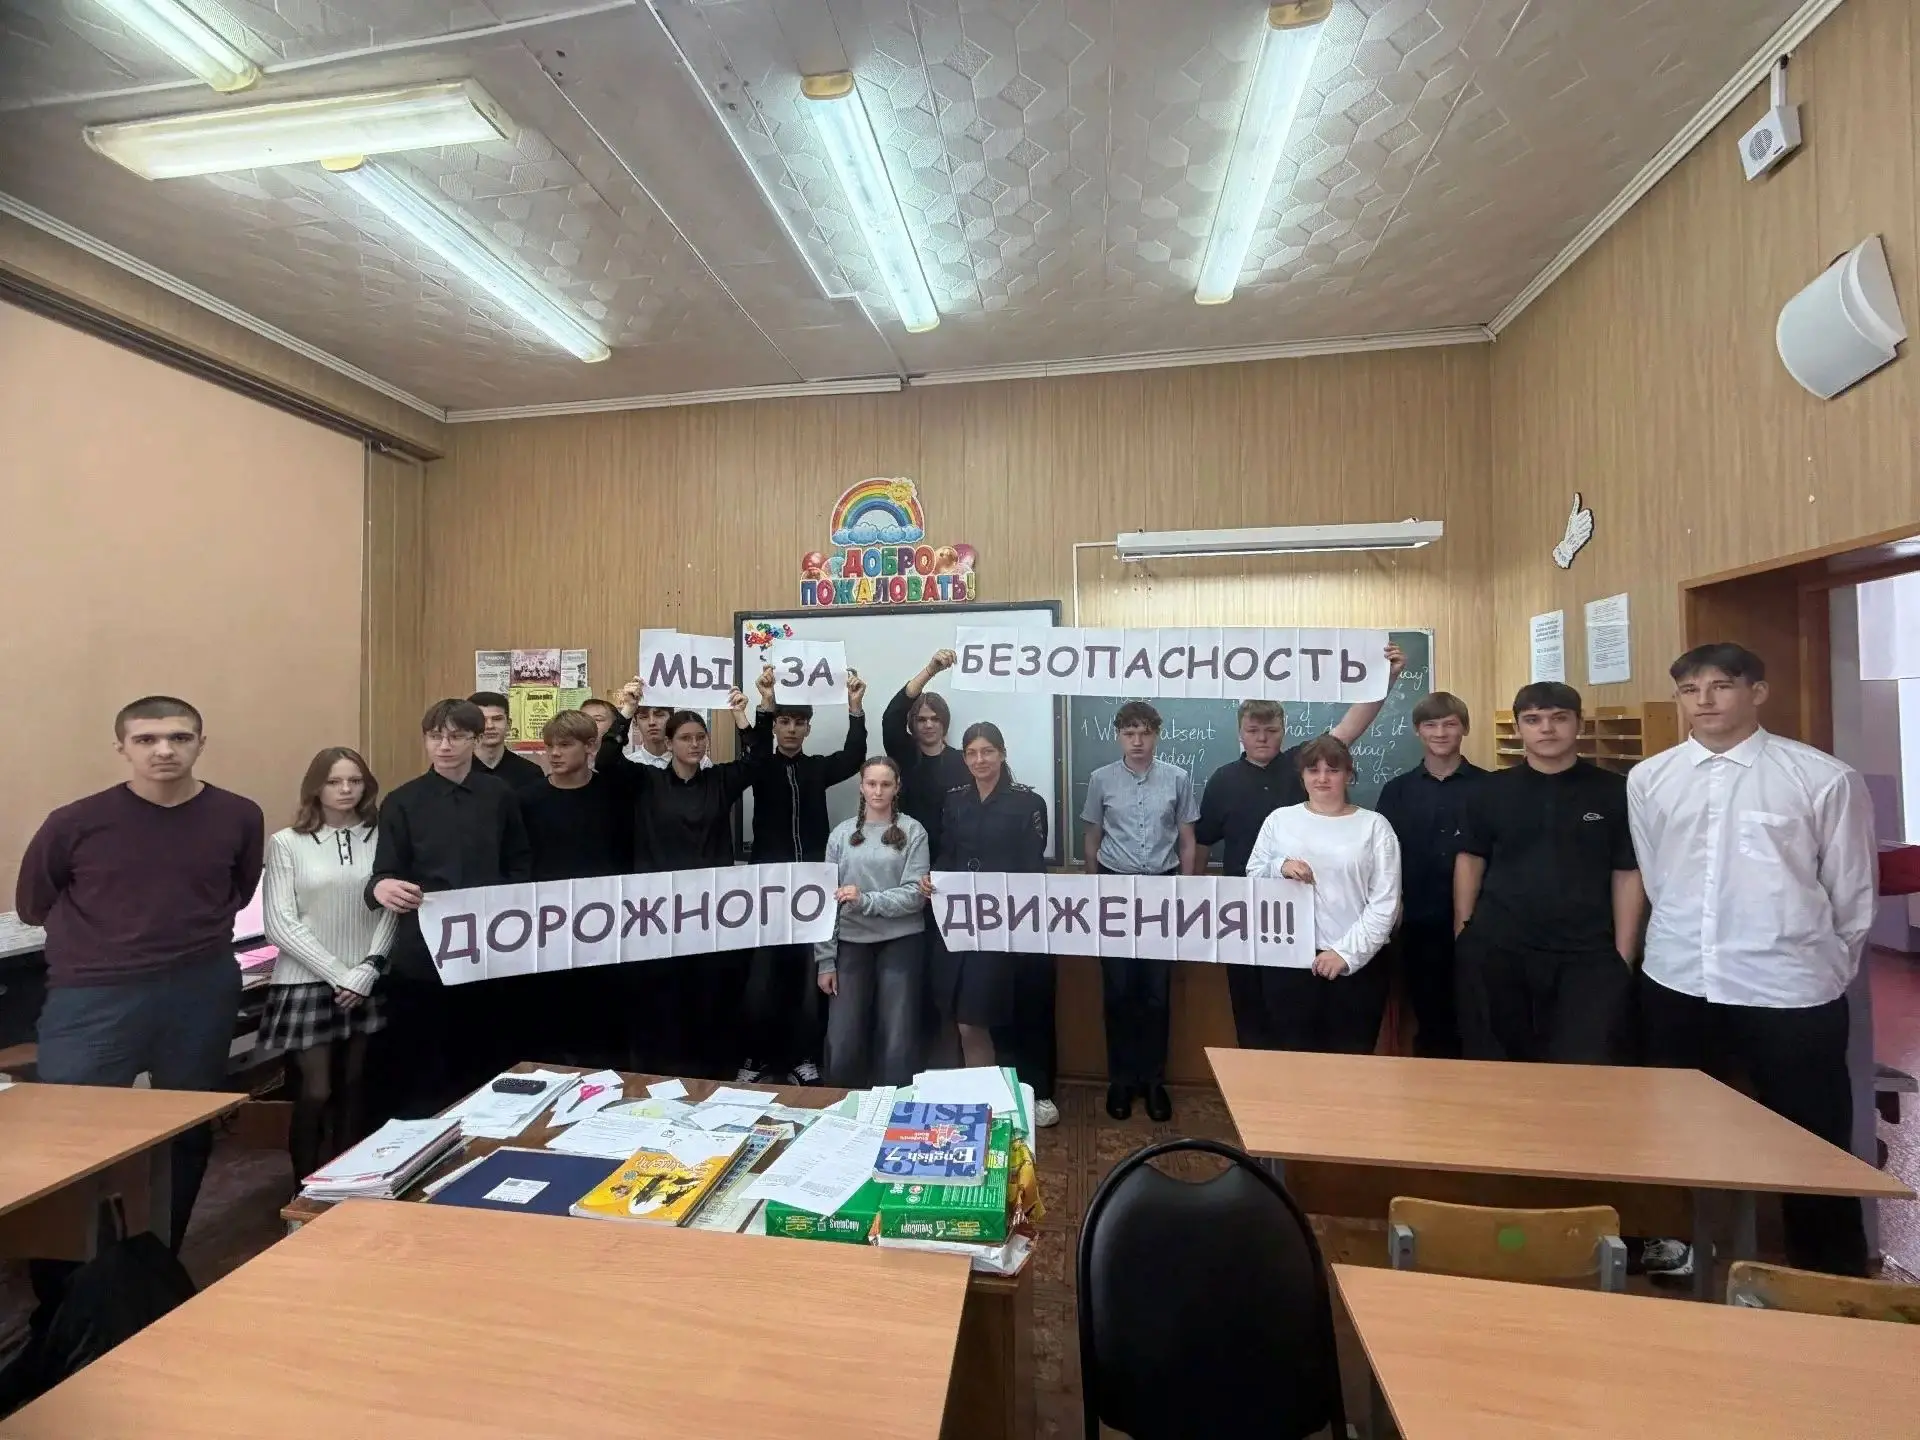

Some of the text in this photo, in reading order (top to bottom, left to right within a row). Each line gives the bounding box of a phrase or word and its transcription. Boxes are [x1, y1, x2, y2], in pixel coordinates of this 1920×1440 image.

[842, 545, 936, 578] ДОБРО
[800, 572, 976, 606] ПОЖАЛОВАТЬ!
[648, 652, 733, 690] МЫ
[781, 656, 835, 688] ЗА
[961, 643, 1367, 683] БЕЗОПАСНОСТЬ
[1160, 719, 1216, 741] absent
[435, 884, 826, 966] ДОРОЖНОГО
[942, 892, 1296, 946] ДВИЖЕНИЯ!!!
[885, 1146, 904, 1161] 7
[907, 1147, 976, 1164] English
